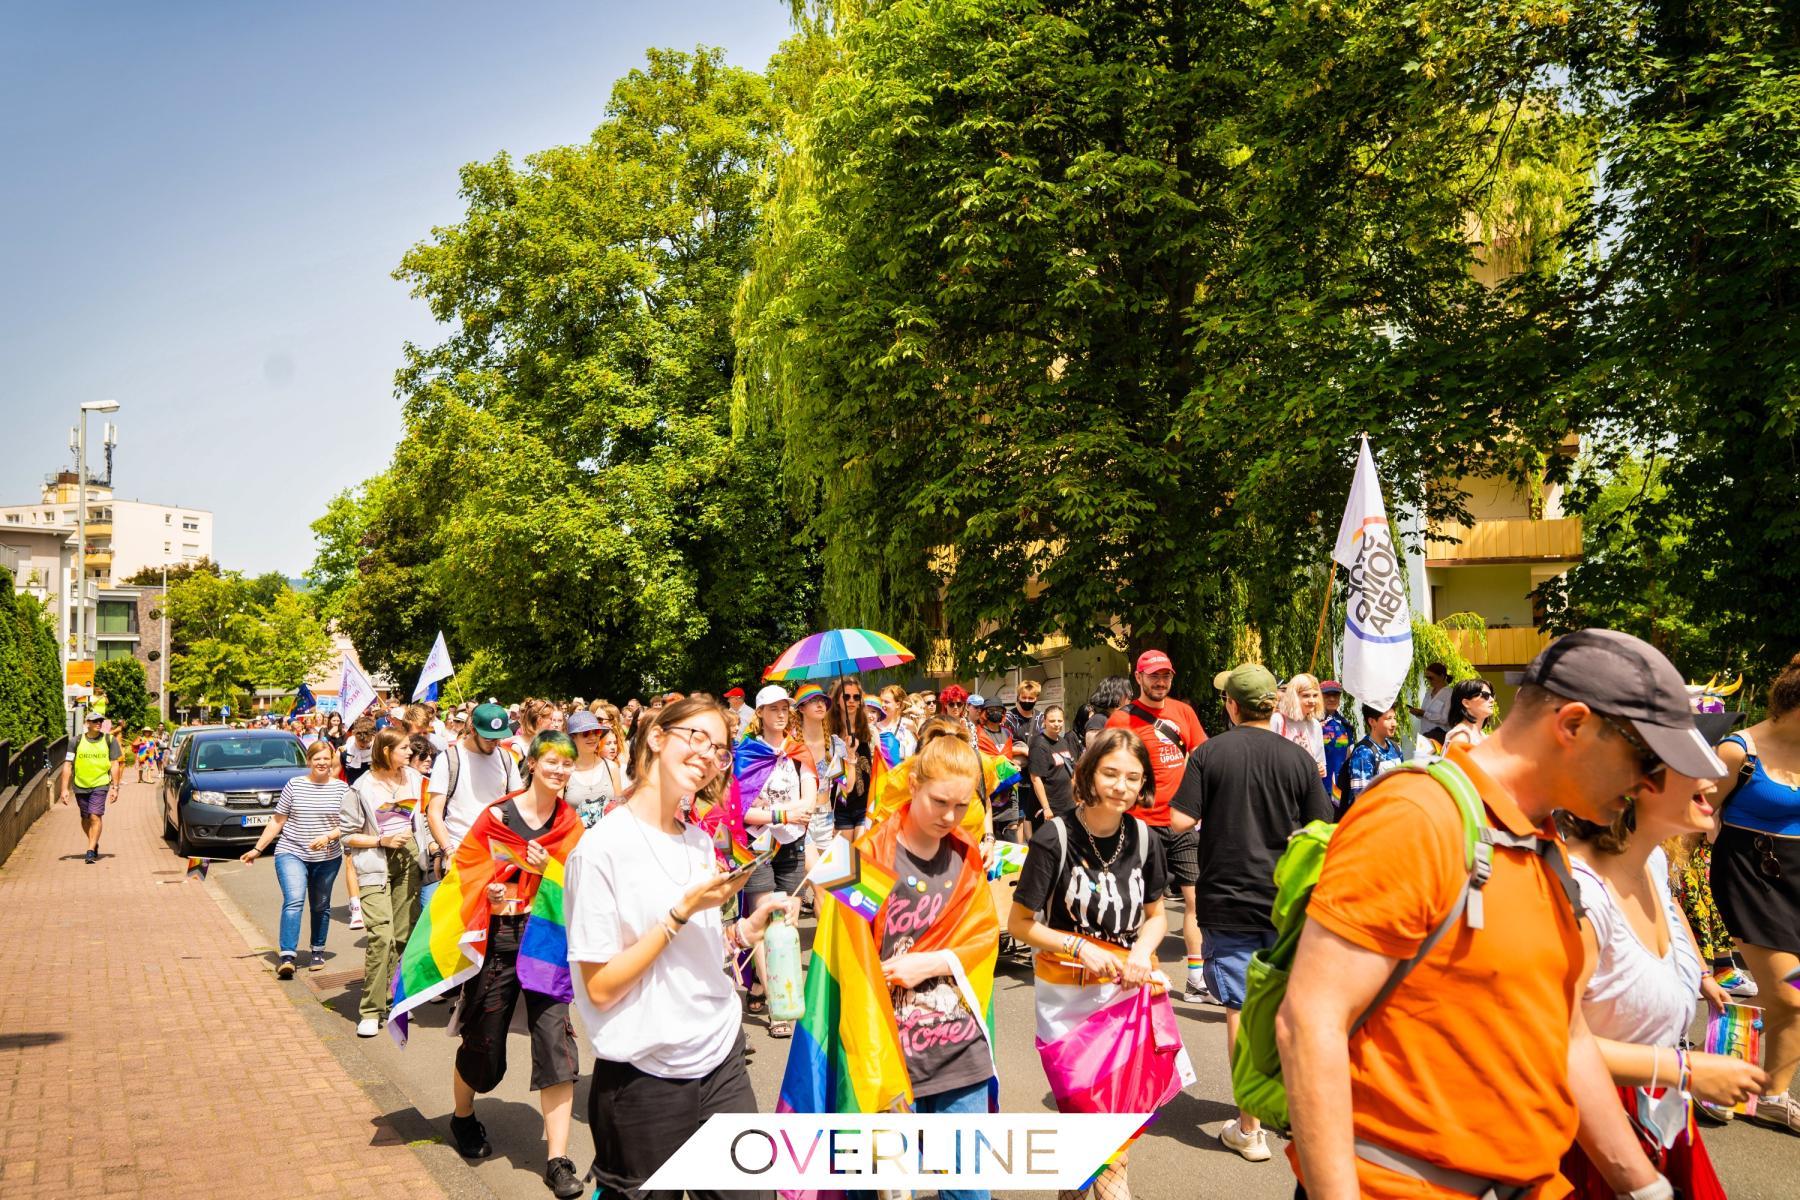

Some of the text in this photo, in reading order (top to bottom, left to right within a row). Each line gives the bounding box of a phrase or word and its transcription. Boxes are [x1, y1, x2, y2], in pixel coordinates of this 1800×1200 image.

[1160, 752, 1185, 764] UPDAT
[246, 816, 262, 824] MTK
[885, 893, 943, 936] Roll
